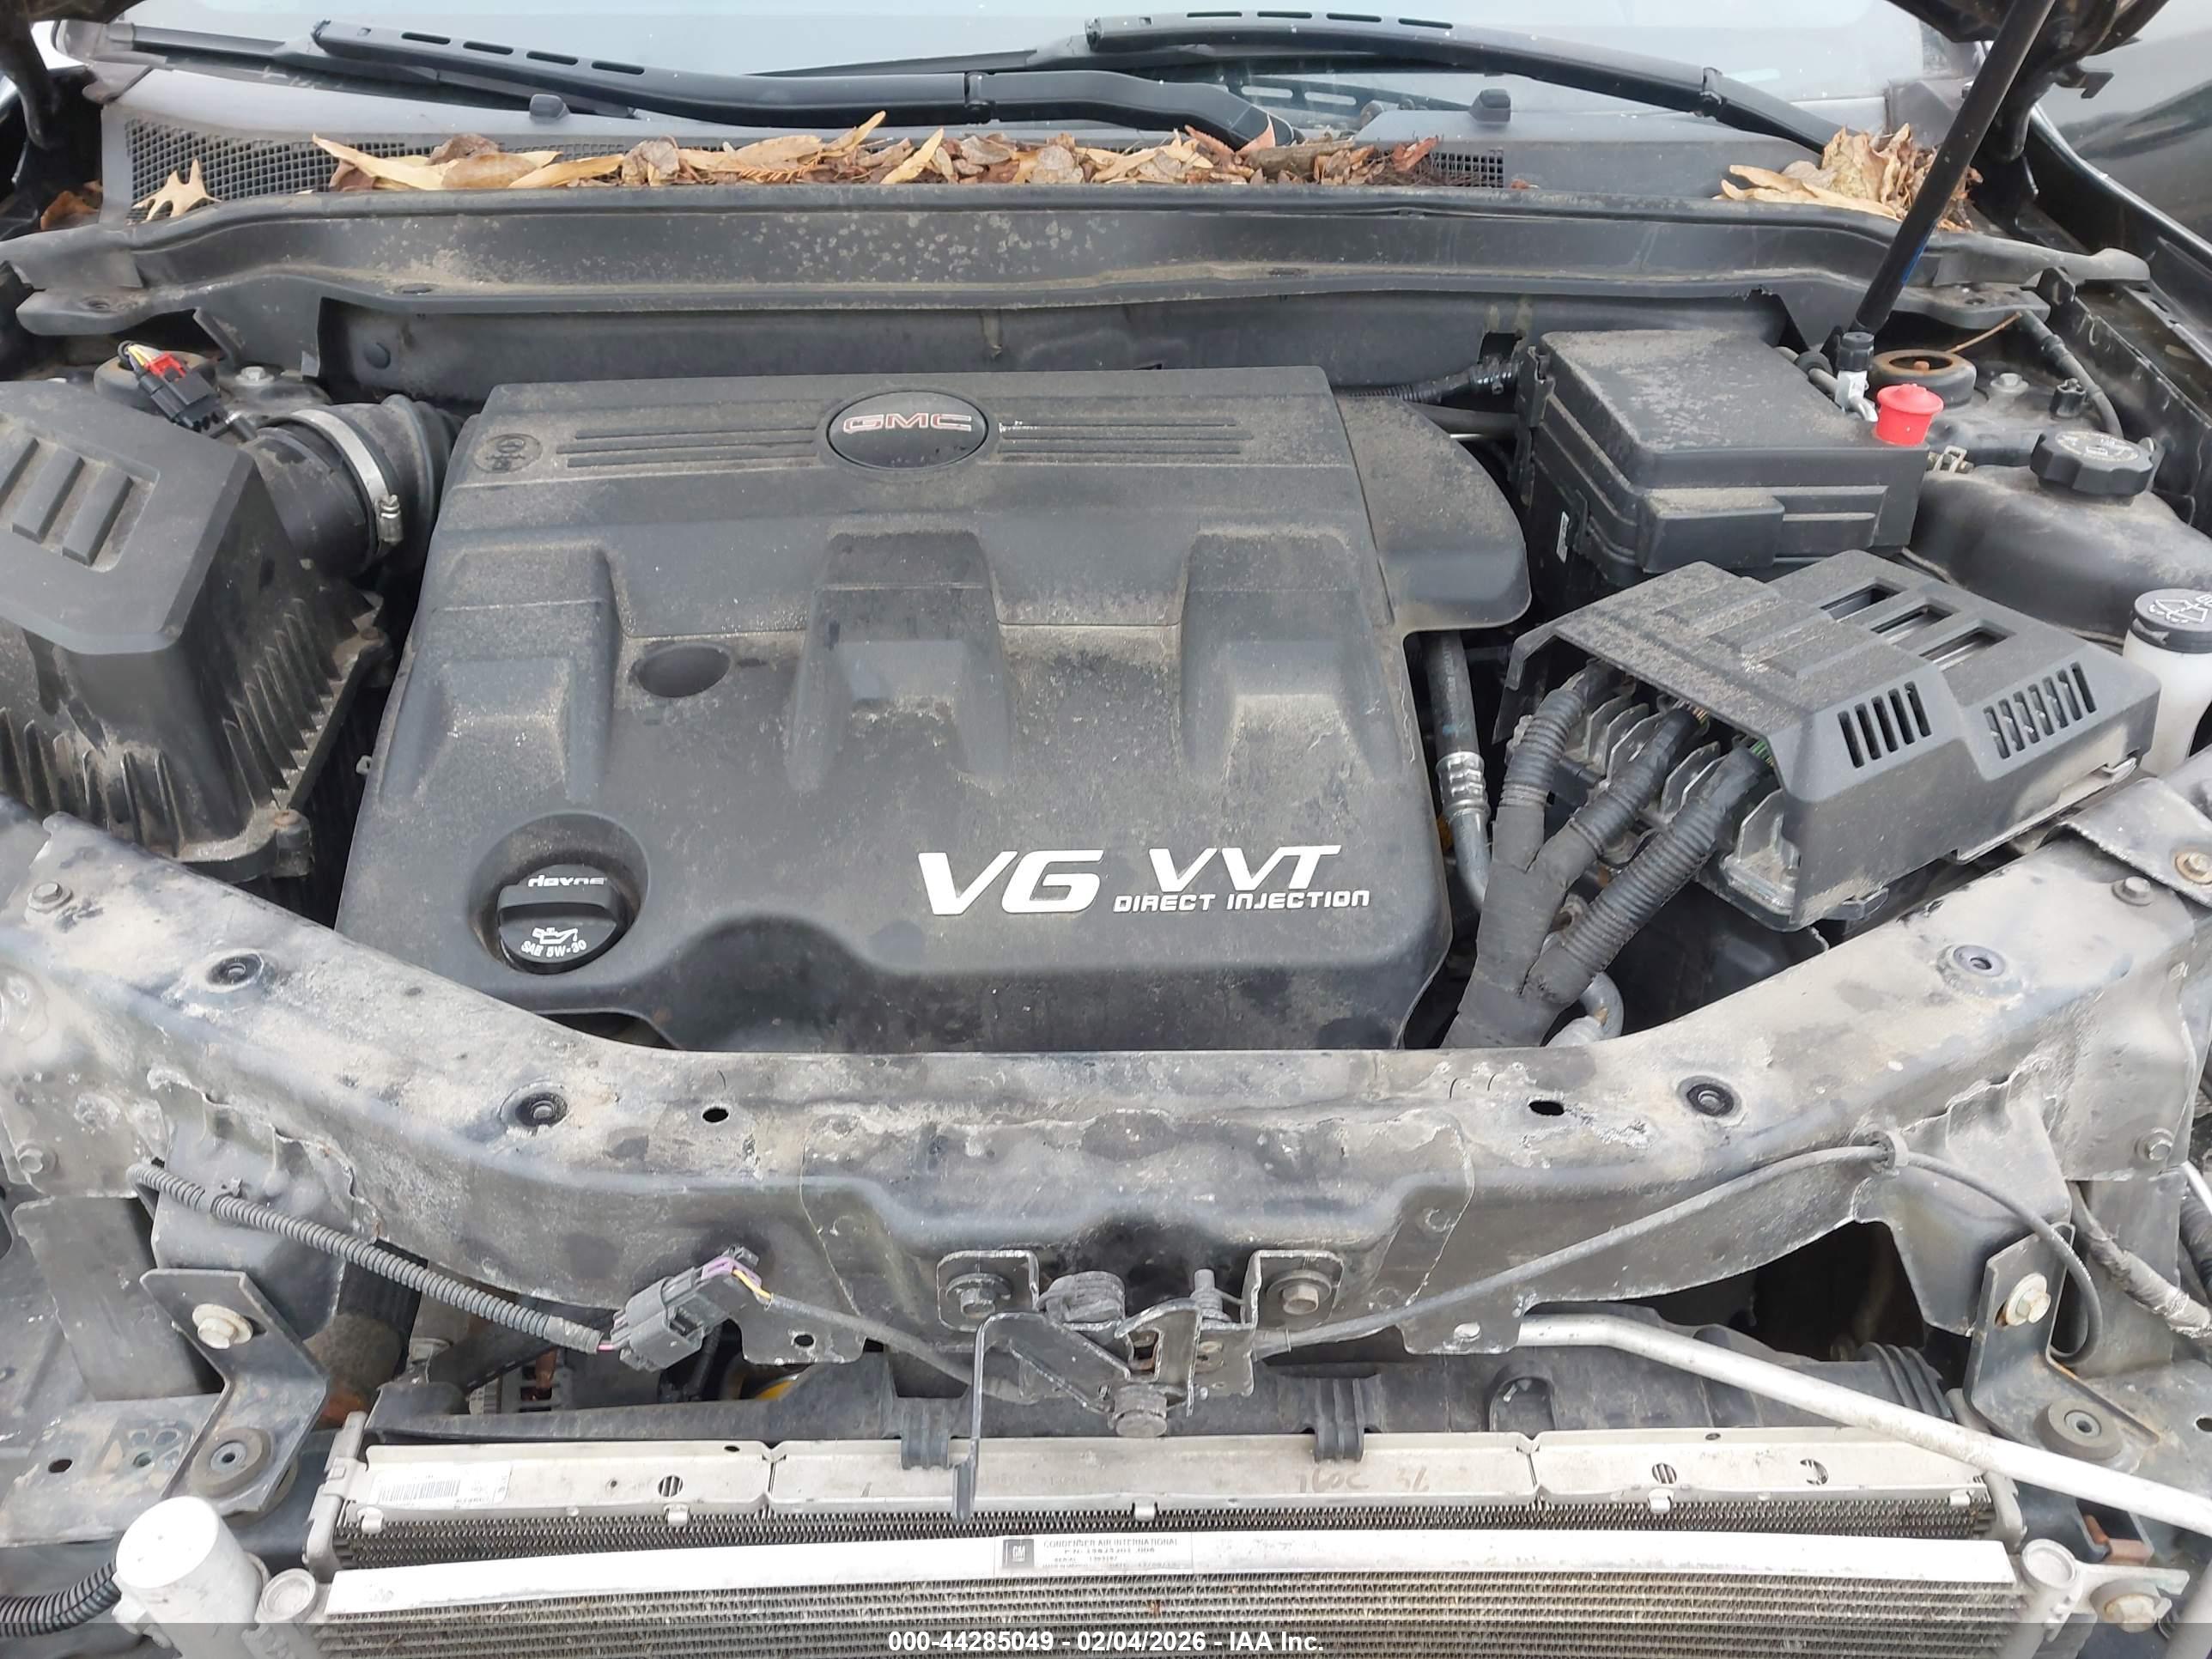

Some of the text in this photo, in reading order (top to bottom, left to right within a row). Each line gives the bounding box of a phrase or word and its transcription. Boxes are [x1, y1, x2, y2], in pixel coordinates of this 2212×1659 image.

[842, 412, 972, 434] GMC
[918, 844, 1342, 915] V6 VVT
[1113, 890, 1370, 913] DIRECT INJECTION
[521, 939, 587, 957] SAE 5W-30
[1114, 1537, 1178, 1547] INTERNATIONAL
[1011, 1545, 1026, 1563] GM
